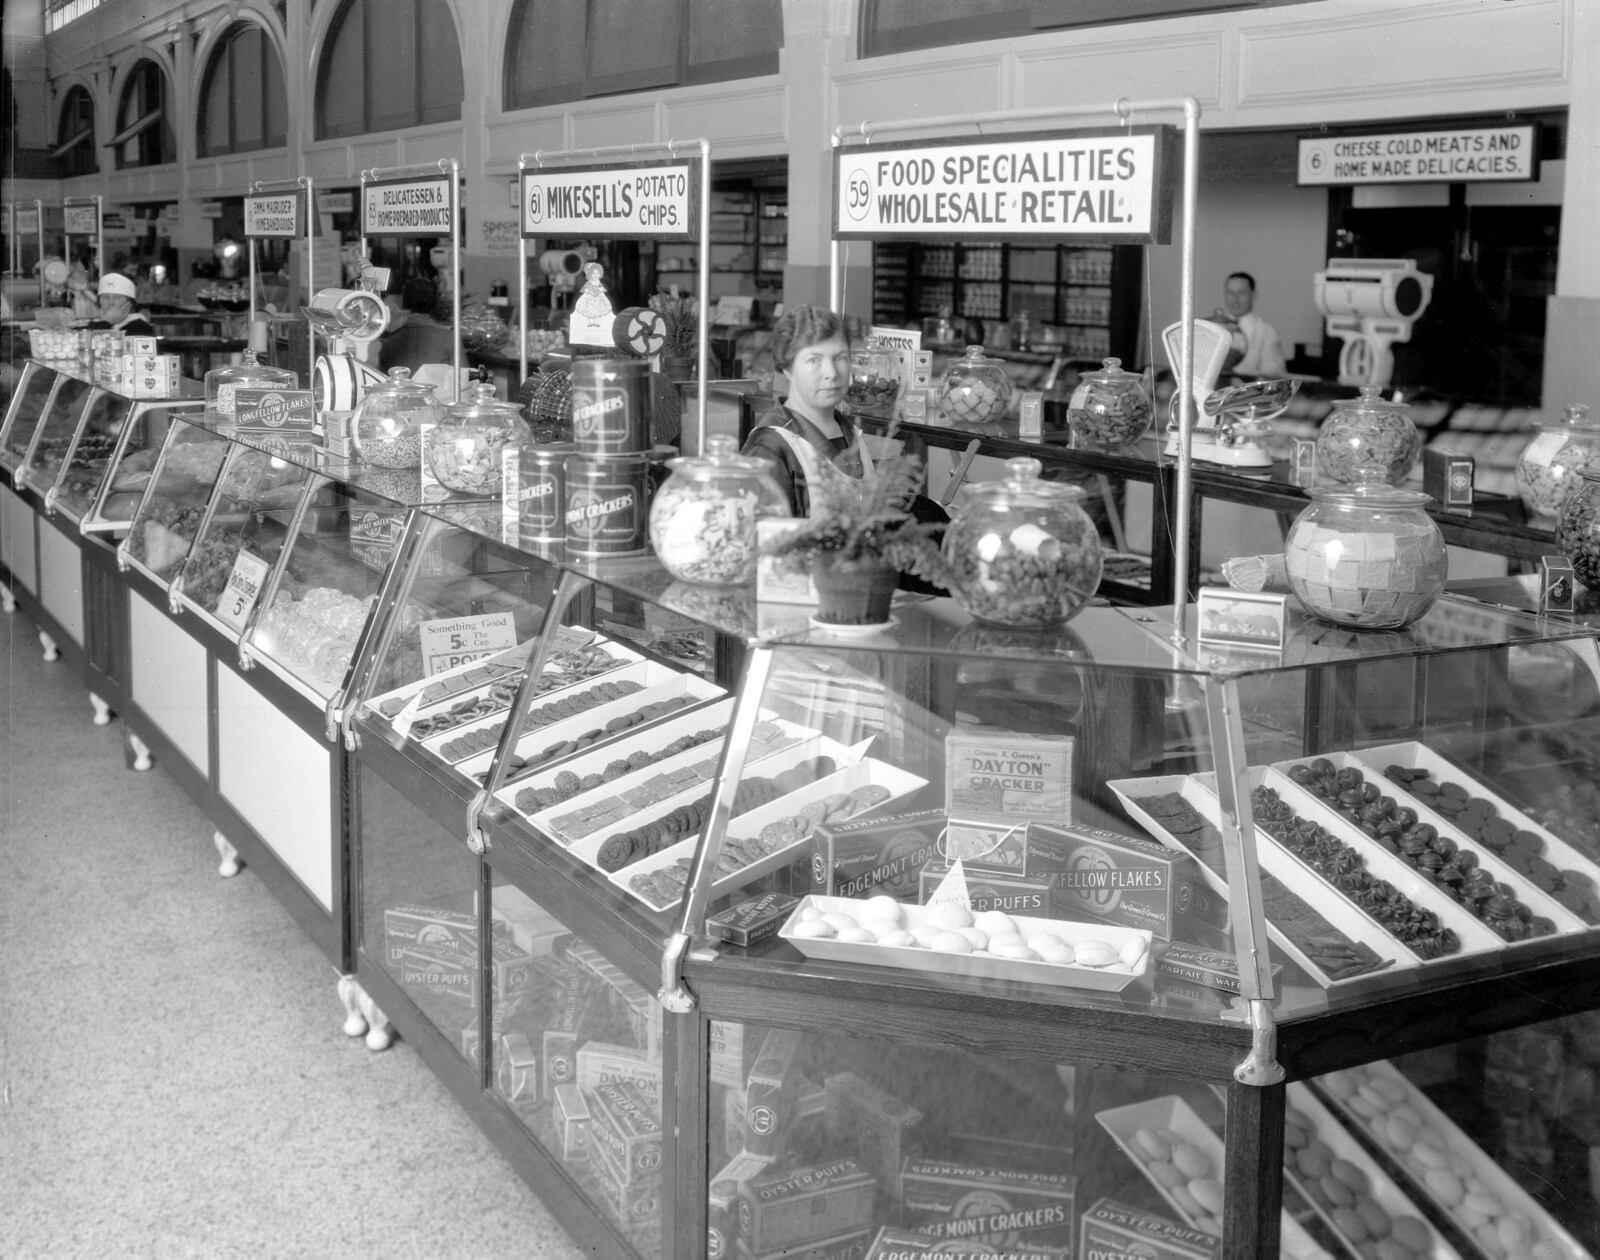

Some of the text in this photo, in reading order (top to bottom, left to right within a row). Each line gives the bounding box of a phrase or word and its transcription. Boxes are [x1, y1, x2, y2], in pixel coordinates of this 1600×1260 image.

[1387, 138, 1426, 156] COLD
[1426, 134, 1485, 153] MEATS
[1488, 133, 1521, 152] AND
[877, 147, 1135, 187] FOOD SPECIALITIES
[1311, 153, 1321, 169] 6
[1334, 155, 1522, 178] HOME MADE DELICACIES.
[383, 185, 443, 206] DELICATESSEN &
[635, 173, 686, 198] POTATO
[849, 180, 869, 208] 59
[530, 193, 541, 215] 61
[547, 180, 633, 219] MIKESELL'S
[877, 189, 1133, 224] WHOLESALE RETAIL.
[378, 207, 450, 227] HOME PREPARED PRODUCTS
[638, 204, 680, 227] CHIPS.
[238, 405, 281, 424] LONGFELLOW
[282, 397, 310, 412] FLAKES
[586, 493, 634, 518] CRACKERS
[427, 617, 508, 634] Something Good
[474, 631, 489, 639] The
[473, 639, 490, 647] Cup
[970, 776, 1045, 791] CRACKER
[839, 856, 908, 898] EDGEMONT
[1111, 870, 1162, 887] FLAKES
[993, 894, 1041, 911] PUFFS
[404, 972, 470, 986] OYSTER PUFFS
[1160, 964, 1201, 979] PARFAIT
[759, 1159, 857, 1200] OYSTER PUFFS
[911, 1165, 985, 1178] CRACKERS
[989, 1204, 1066, 1232] CRACKERS
[1095, 1209, 1216, 1246] OYSTER PUFFS
